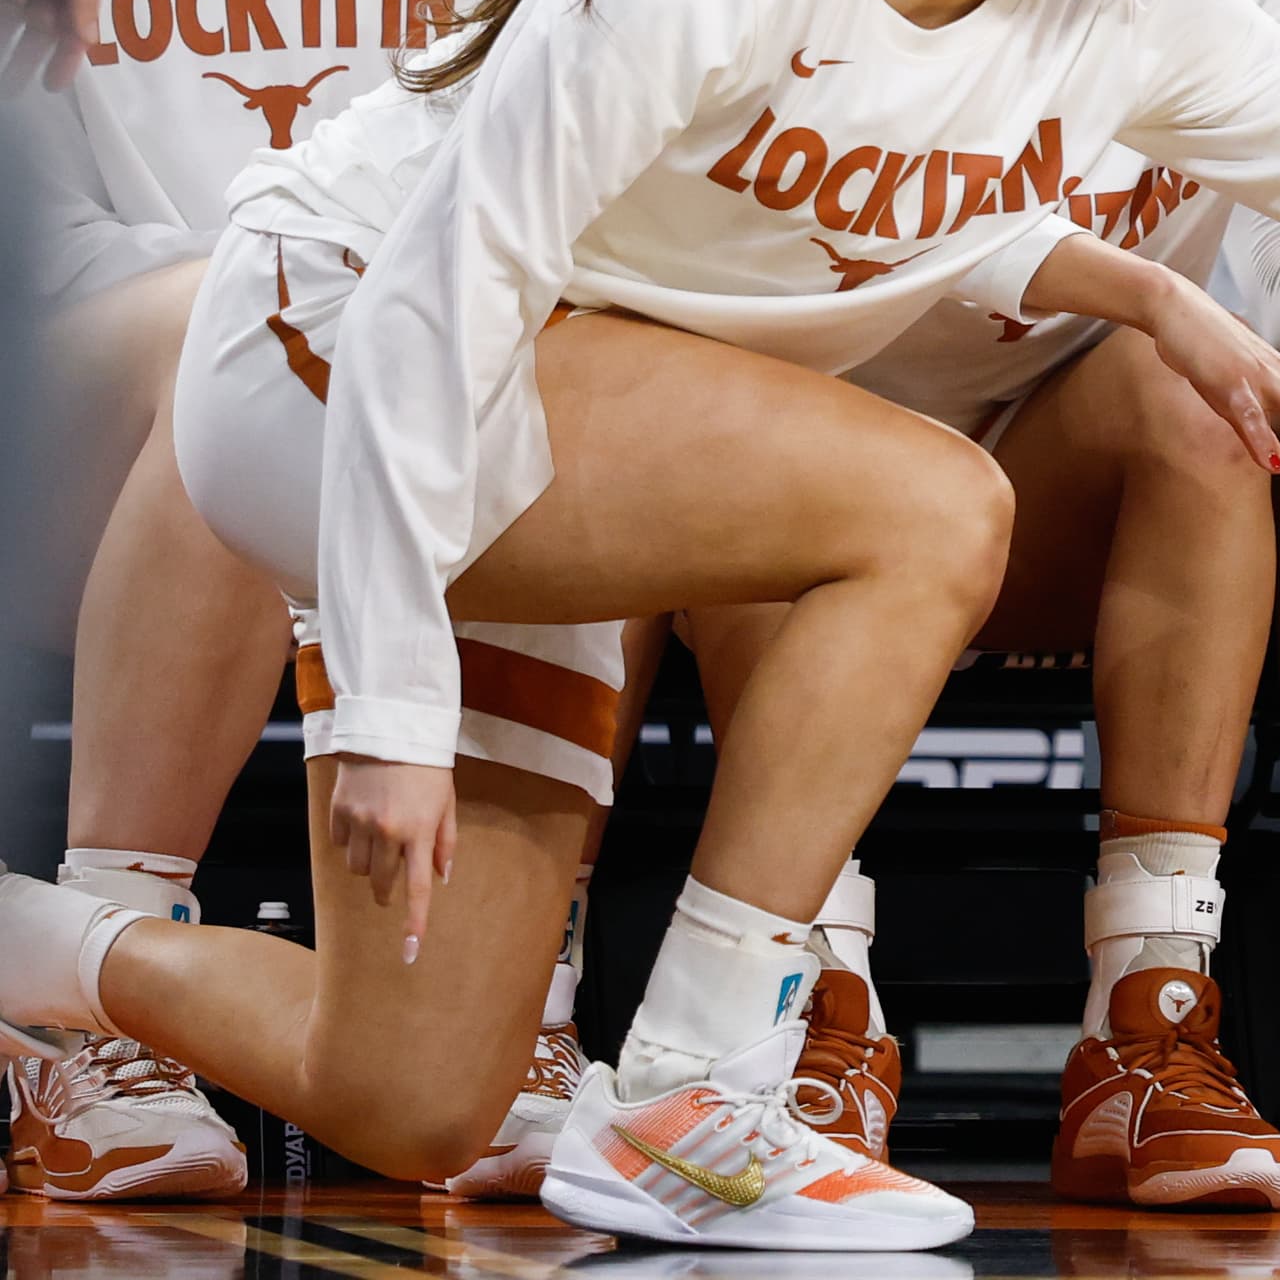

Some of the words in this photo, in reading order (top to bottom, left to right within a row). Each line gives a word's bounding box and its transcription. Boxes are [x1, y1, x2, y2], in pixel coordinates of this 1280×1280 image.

[706, 106, 928, 241] LOCK
[914, 149, 1004, 240] IT
[974, 117, 1064, 217] N
